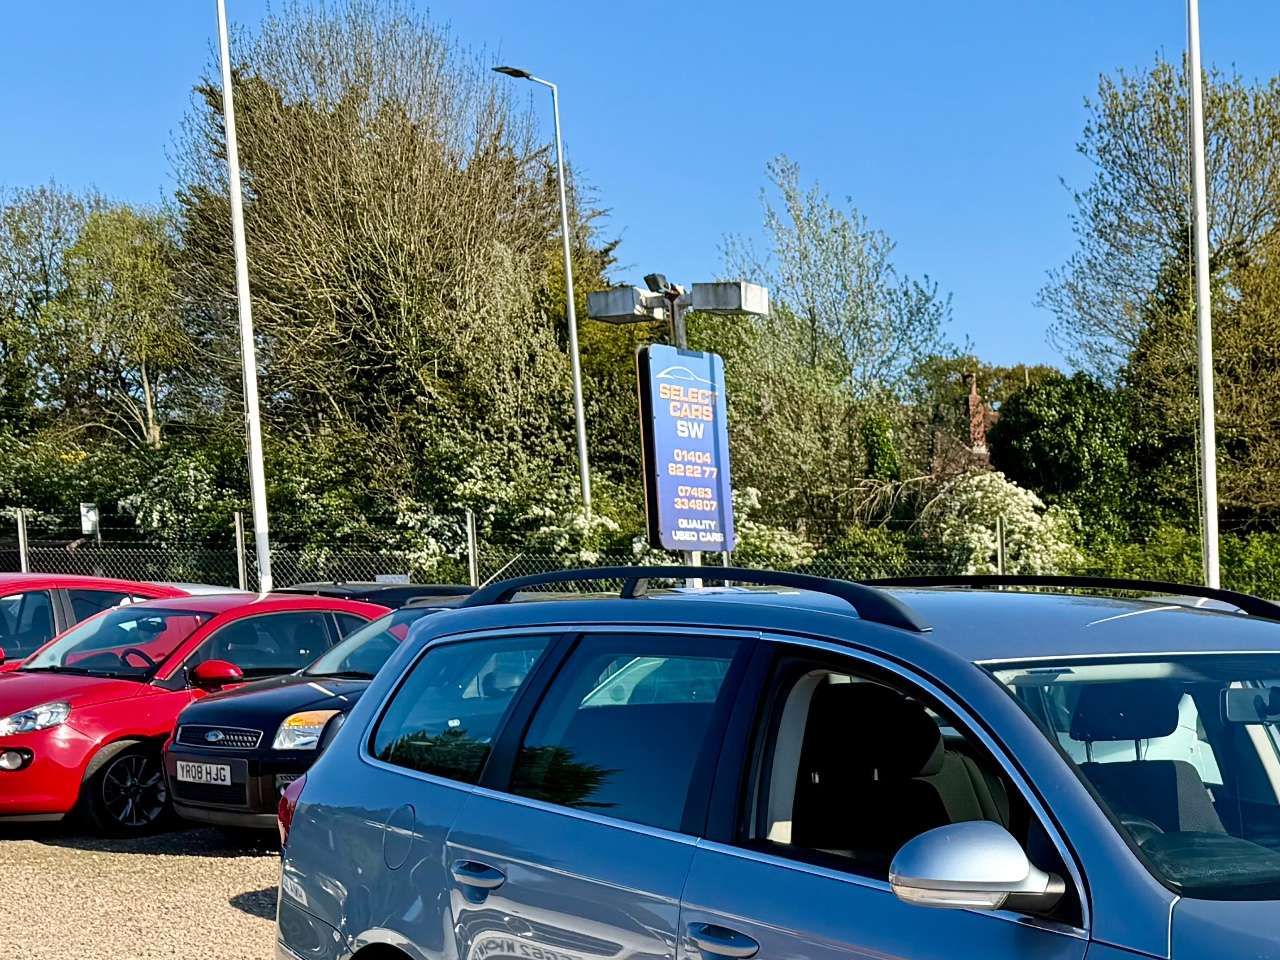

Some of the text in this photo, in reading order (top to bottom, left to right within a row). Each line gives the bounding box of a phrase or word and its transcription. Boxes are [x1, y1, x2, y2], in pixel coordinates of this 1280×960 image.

[659, 383, 718, 404] SELECT
[670, 401, 713, 422] CARS
[677, 420, 704, 439] SW
[674, 448, 711, 464] 01404
[674, 498, 718, 511] 334807
[678, 518, 717, 530] QUALITY
[672, 530, 724, 543] USED CARS
[180, 763, 226, 782] YR08 HJG
